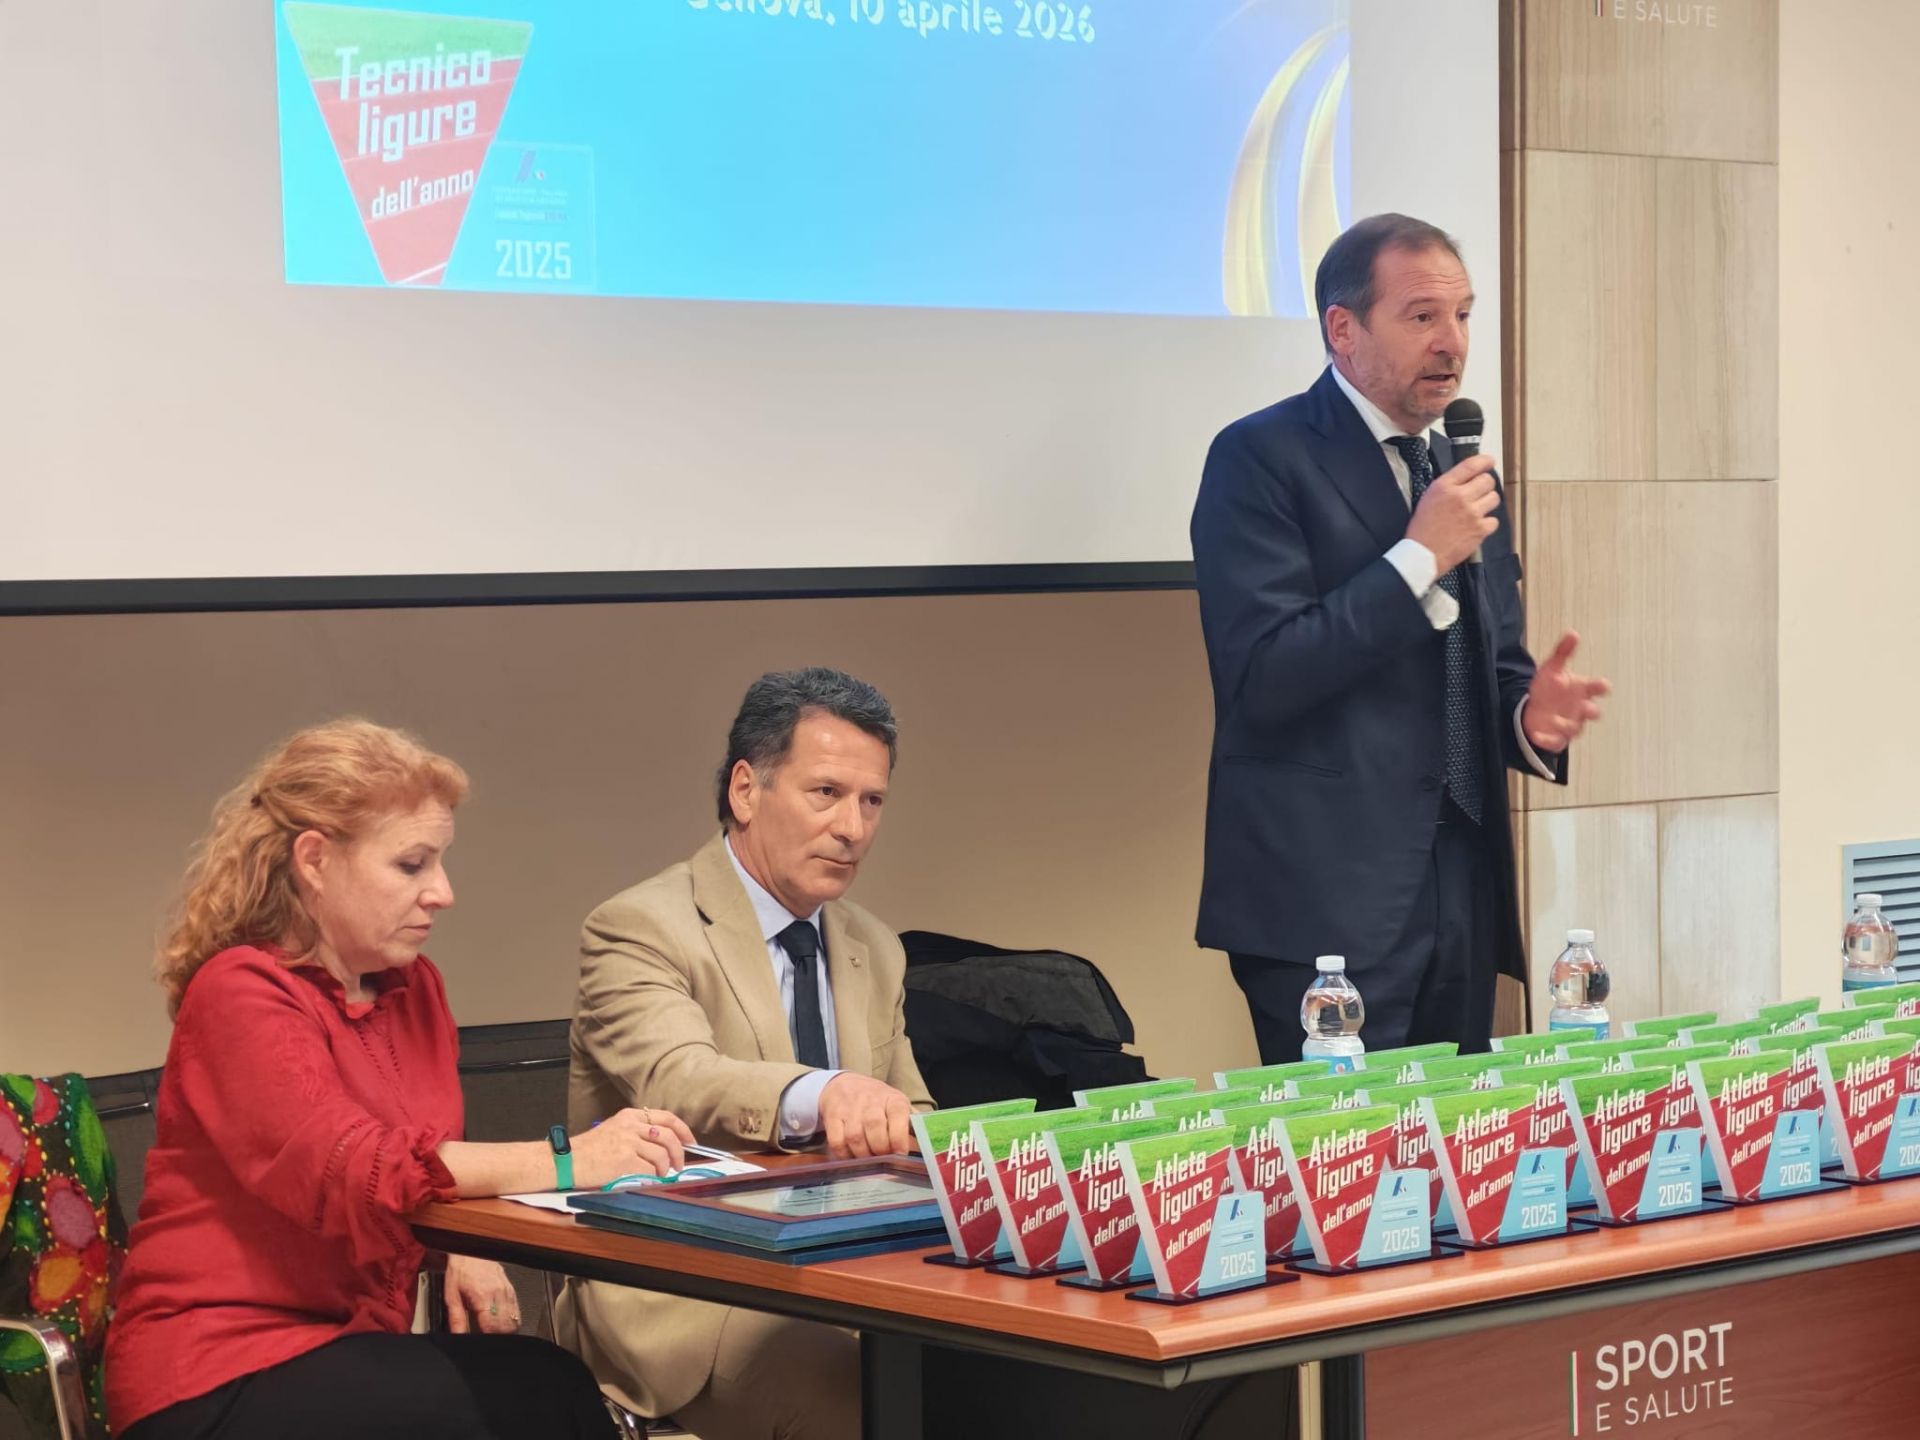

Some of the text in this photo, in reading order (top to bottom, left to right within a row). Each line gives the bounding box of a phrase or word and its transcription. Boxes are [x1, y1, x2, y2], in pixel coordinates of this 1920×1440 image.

[687, 0, 835, 26] ova,
[897, 0, 1003, 39] aprile
[1014, 0, 1095, 43] 2026
[1614, 0, 1717, 27] E SALUTE
[335, 43, 491, 101] Tecnico
[358, 100, 476, 163] ligure
[371, 169, 474, 220] dell'anno
[496, 239, 572, 279] 2025
[1719, 1071, 1768, 1109] Atleta
[1783, 1073, 1822, 1109] ligur
[1843, 1055, 1890, 1092] Atleta
[1594, 1088, 1646, 1126] Atleta
[1660, 1092, 1696, 1127] igur
[1726, 1095, 1774, 1136] ligure
[1849, 1078, 1895, 1118] ligure
[1391, 1099, 1425, 1137] Atle
[1454, 1107, 1509, 1146] Atleta
[1529, 1109, 1569, 1144] ligur
[1600, 1112, 1652, 1155] ligure
[1853, 1113, 1893, 1148] dell'anno
[1006, 1132, 1047, 1171] Atle
[1080, 1142, 1120, 1182] Atle
[1308, 1128, 1367, 1169] Atleta
[1397, 1131, 1430, 1166] ligu
[1461, 1132, 1515, 1176] ligure
[1731, 1131, 1773, 1166] dell'anno
[1899, 1144, 1920, 1167] 202
[1015, 1165, 1056, 1201] ligu
[1152, 1151, 1206, 1194] Atleta
[1316, 1153, 1374, 1199] ligure
[1606, 1150, 1650, 1186] dell'anno
[1780, 1162, 1812, 1187] 2025
[1087, 1176, 1128, 1212] ligu
[1160, 1176, 1213, 1225] ligure
[1265, 1192, 1295, 1217] ell'an
[1467, 1171, 1513, 1209] dell'anno
[1658, 1181, 1692, 1207] 2025
[960, 1196, 997, 1225] dell'an
[1021, 1201, 1066, 1234] dell'ann
[1322, 1193, 1373, 1233] dell'anno
[1521, 1203, 1557, 1229] 2025
[1094, 1213, 1136, 1247] dell'ann
[1166, 1218, 1212, 1260] dell'anno
[1382, 1226, 1420, 1253] 2025
[1221, 1250, 1256, 1279] 2025
[1595, 1321, 1733, 1391] SPORT
[1596, 1377, 1734, 1432] E SALUTE
